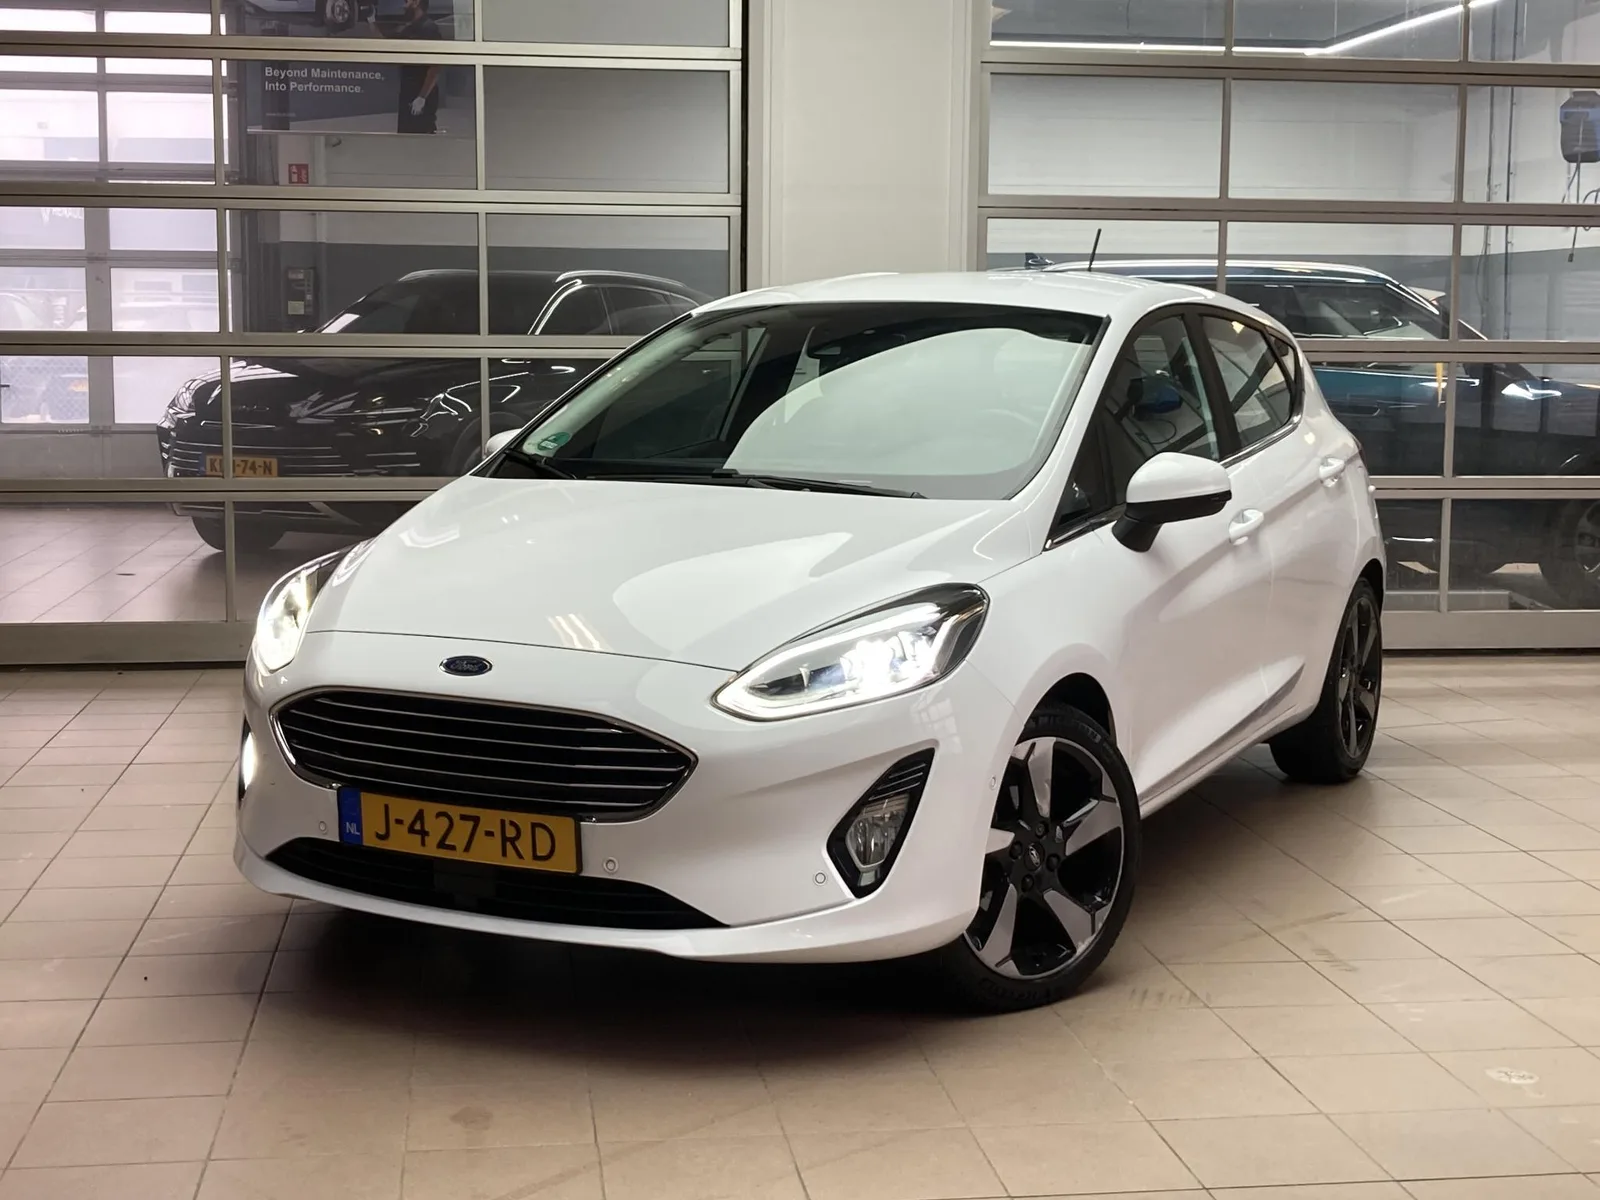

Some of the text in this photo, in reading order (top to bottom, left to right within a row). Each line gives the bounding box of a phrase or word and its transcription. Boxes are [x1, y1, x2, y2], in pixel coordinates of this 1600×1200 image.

[265, 67, 385, 81] Beyond Maintenance,
[265, 81, 364, 94] Into Performance.
[209, 458, 272, 475] K-74-N
[346, 822, 361, 836] NL
[374, 803, 556, 862] J-427-RD
